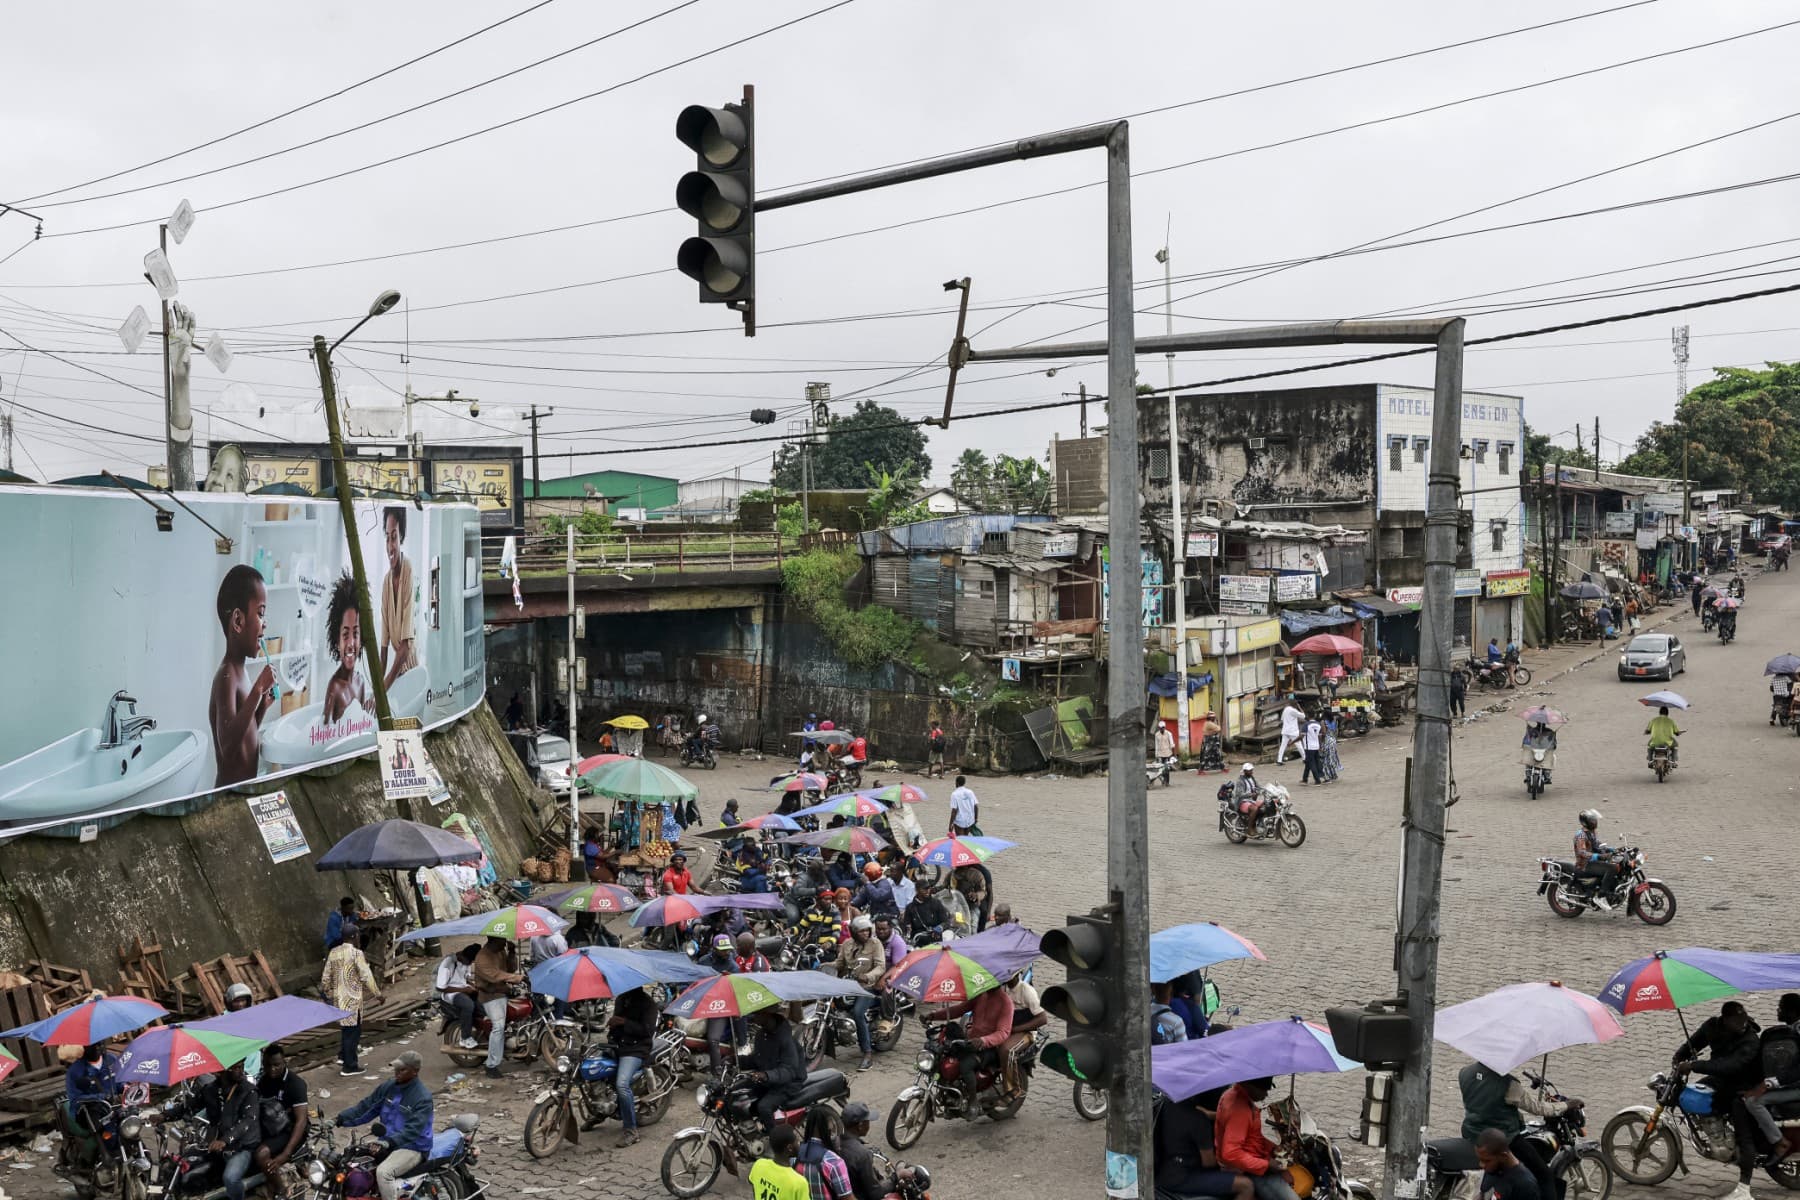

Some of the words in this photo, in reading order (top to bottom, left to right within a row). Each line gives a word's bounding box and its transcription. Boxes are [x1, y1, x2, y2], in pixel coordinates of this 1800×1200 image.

[1389, 397, 1431, 417] MOTEL
[393, 769, 416, 779] COURS
[384, 777, 427, 789] D'ALLEMAND
[259, 801, 279, 813] COURS
